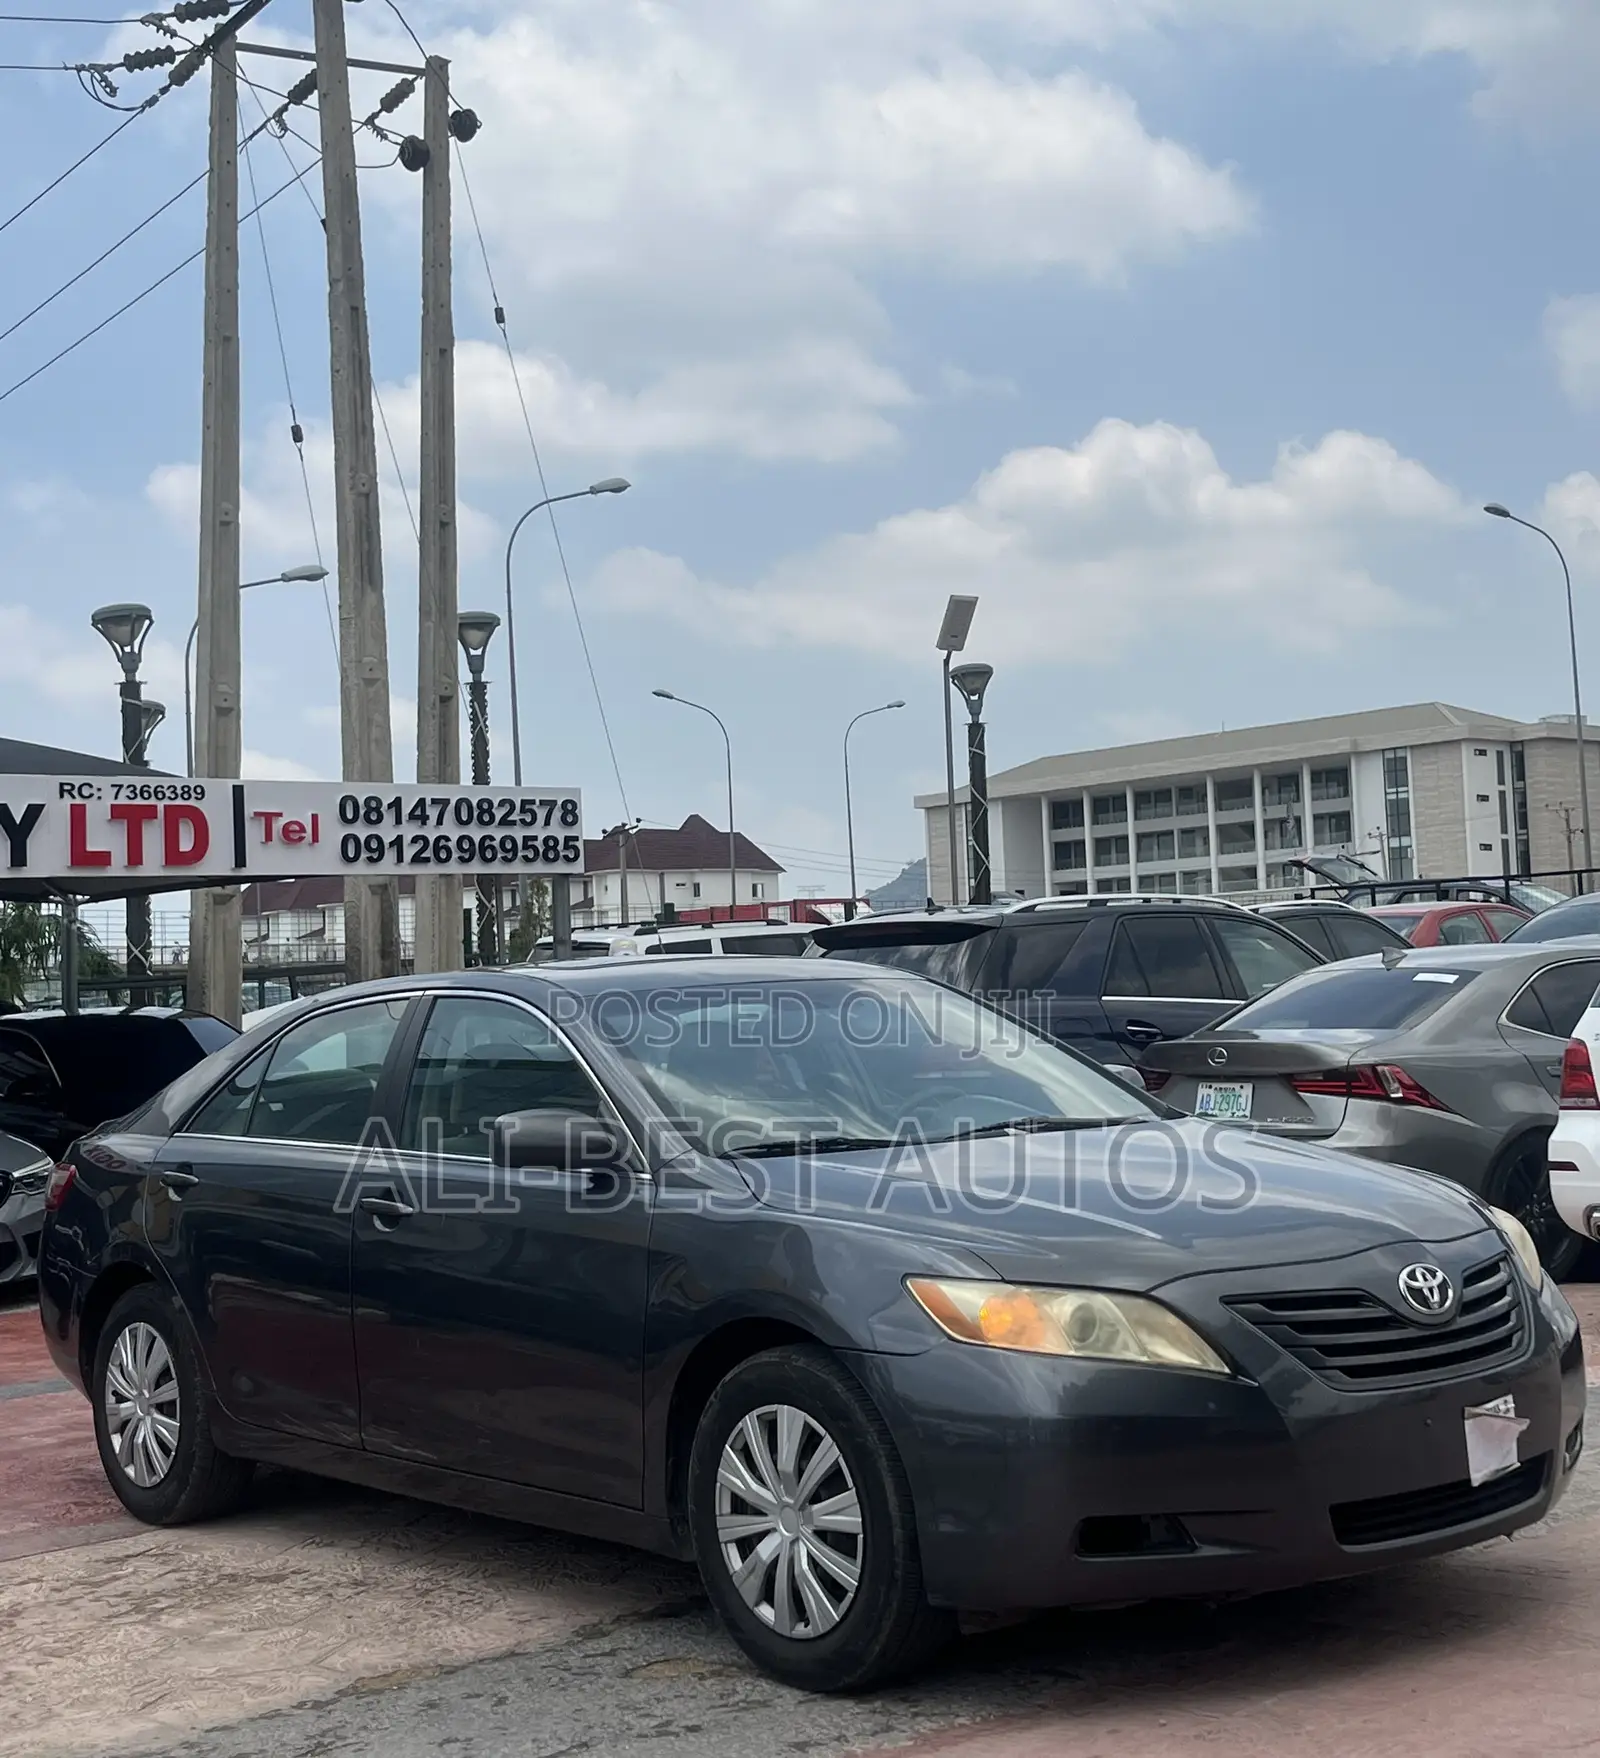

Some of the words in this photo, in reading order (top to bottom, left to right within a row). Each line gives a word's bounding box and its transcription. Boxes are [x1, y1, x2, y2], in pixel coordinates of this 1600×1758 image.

[58, 782, 102, 800] RC:
[110, 783, 206, 801] 7366389
[338, 794, 579, 827] 08147082578
[69, 803, 210, 867] LTD
[253, 811, 319, 844] Tel
[340, 832, 581, 864] 09126969585
